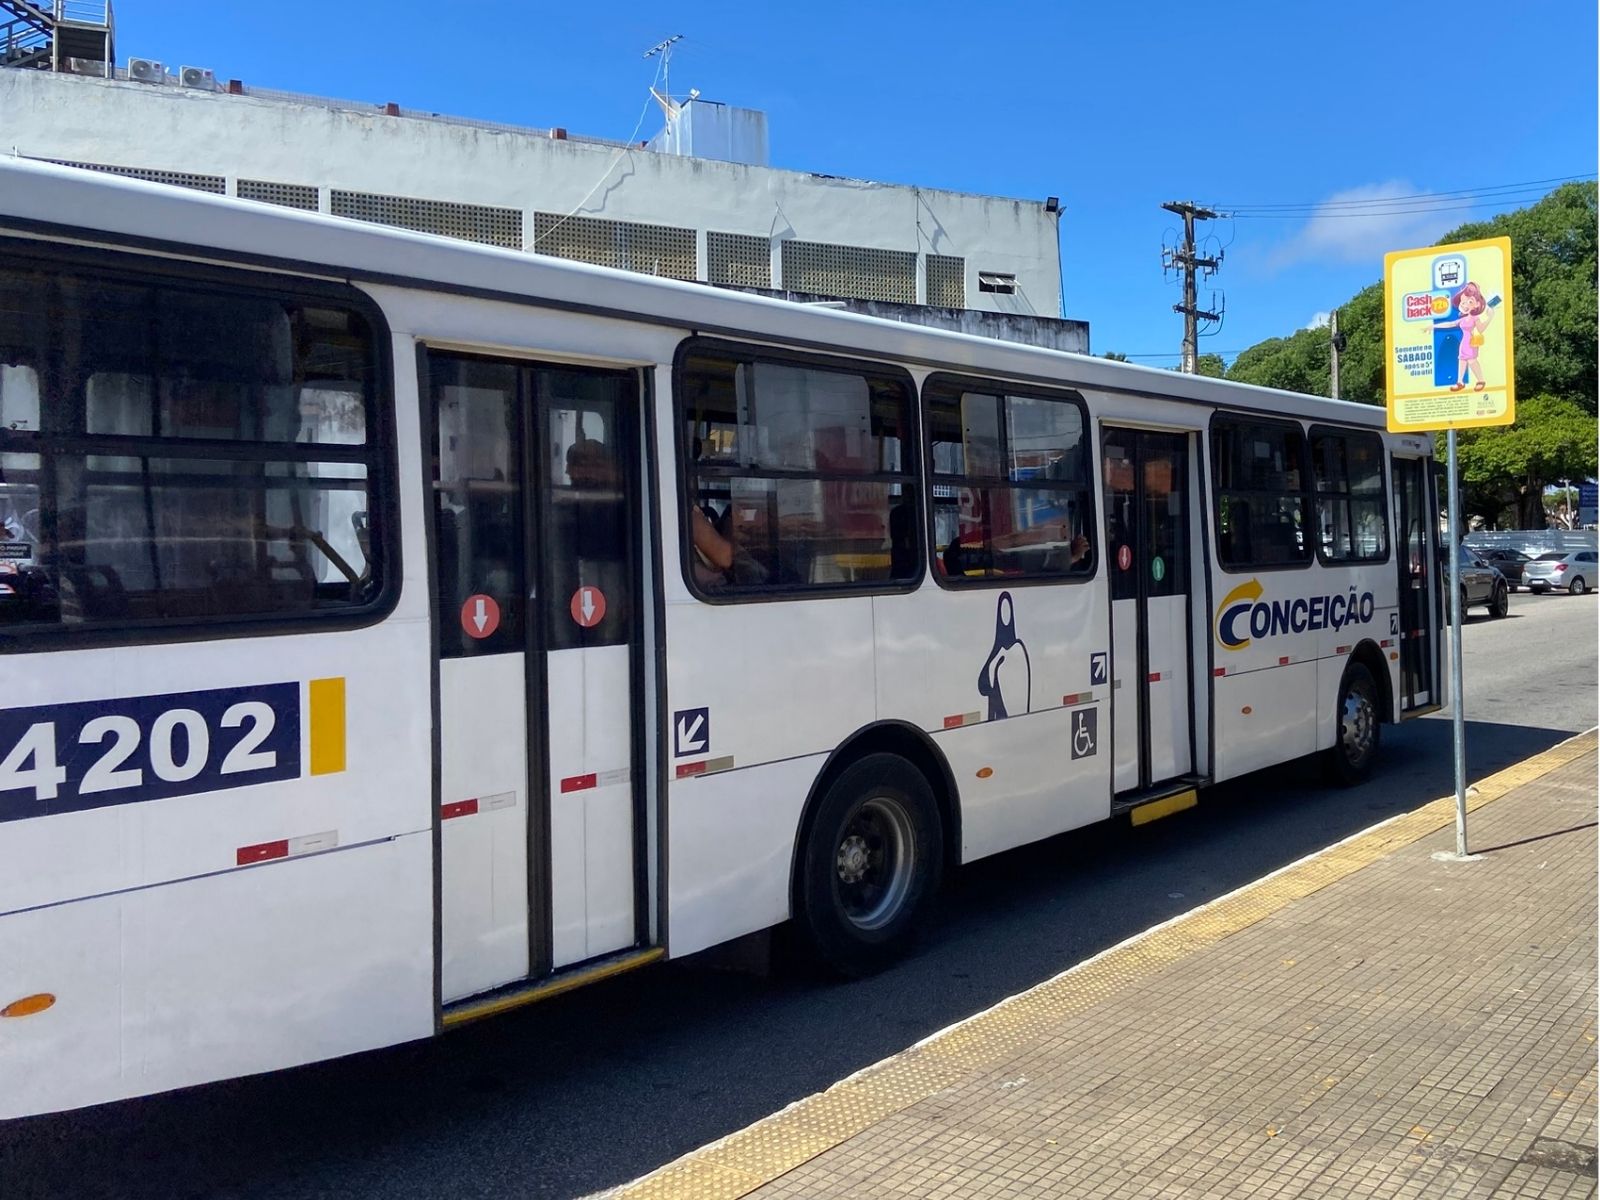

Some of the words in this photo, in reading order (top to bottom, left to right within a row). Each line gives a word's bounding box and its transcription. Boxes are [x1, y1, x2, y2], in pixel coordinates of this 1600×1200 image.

[1407, 294, 1432, 306] Cash
[1407, 305, 1432, 318] back
[1395, 345, 1423, 353] Somente
[1219, 585, 1374, 647] CONCEIÇÃO
[0, 701, 276, 801] 4202
